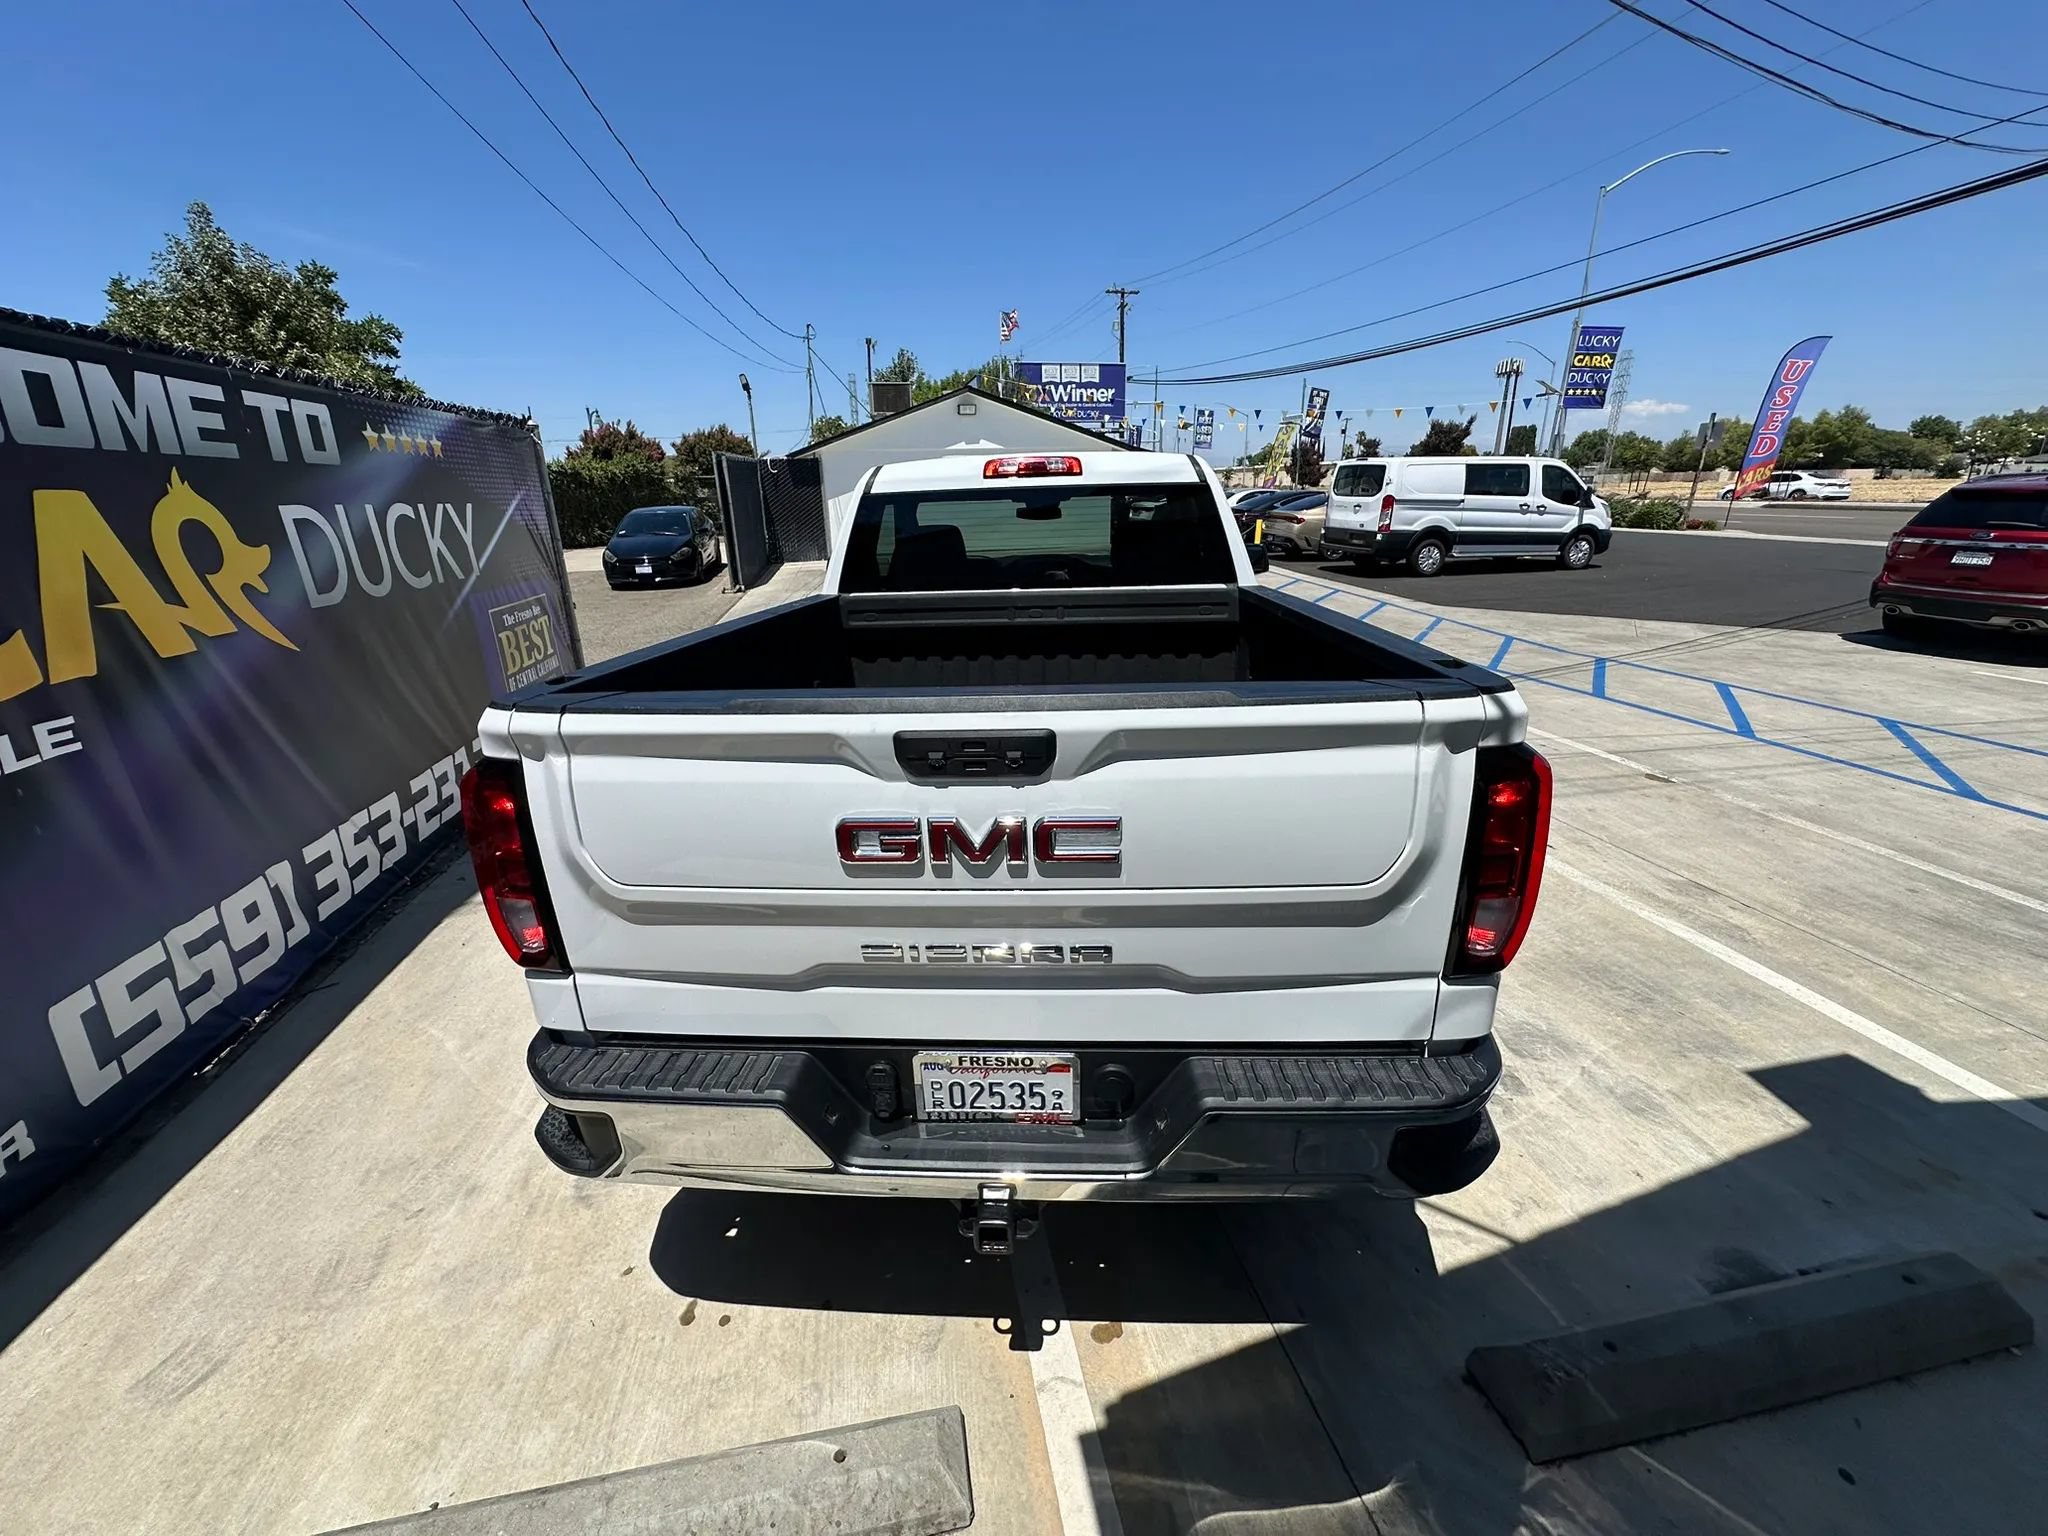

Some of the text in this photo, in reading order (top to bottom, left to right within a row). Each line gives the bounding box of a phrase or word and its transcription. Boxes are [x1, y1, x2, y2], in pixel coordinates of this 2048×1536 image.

[1578, 335, 1621, 347] LUCKY
[1051, 384, 1115, 402] Winner
[1568, 373, 1611, 384] DUCKY
[0, 345, 341, 466] OME TO
[1749, 359, 1814, 458] USED
[278, 503, 481, 608] DUCKY
[502, 614, 515, 626] The
[514, 608, 533, 623] Fresno
[498, 615, 554, 675] BEST
[0, 714, 83, 775] LE
[836, 816, 1122, 864] GMC
[48, 736, 481, 1107] (559) 353-231
[860, 943, 1113, 963] SIERRA
[958, 1055, 1034, 1067] FRESNO
[948, 1080, 1047, 1111] 02535
[1014, 1112, 1073, 1125] GMC
